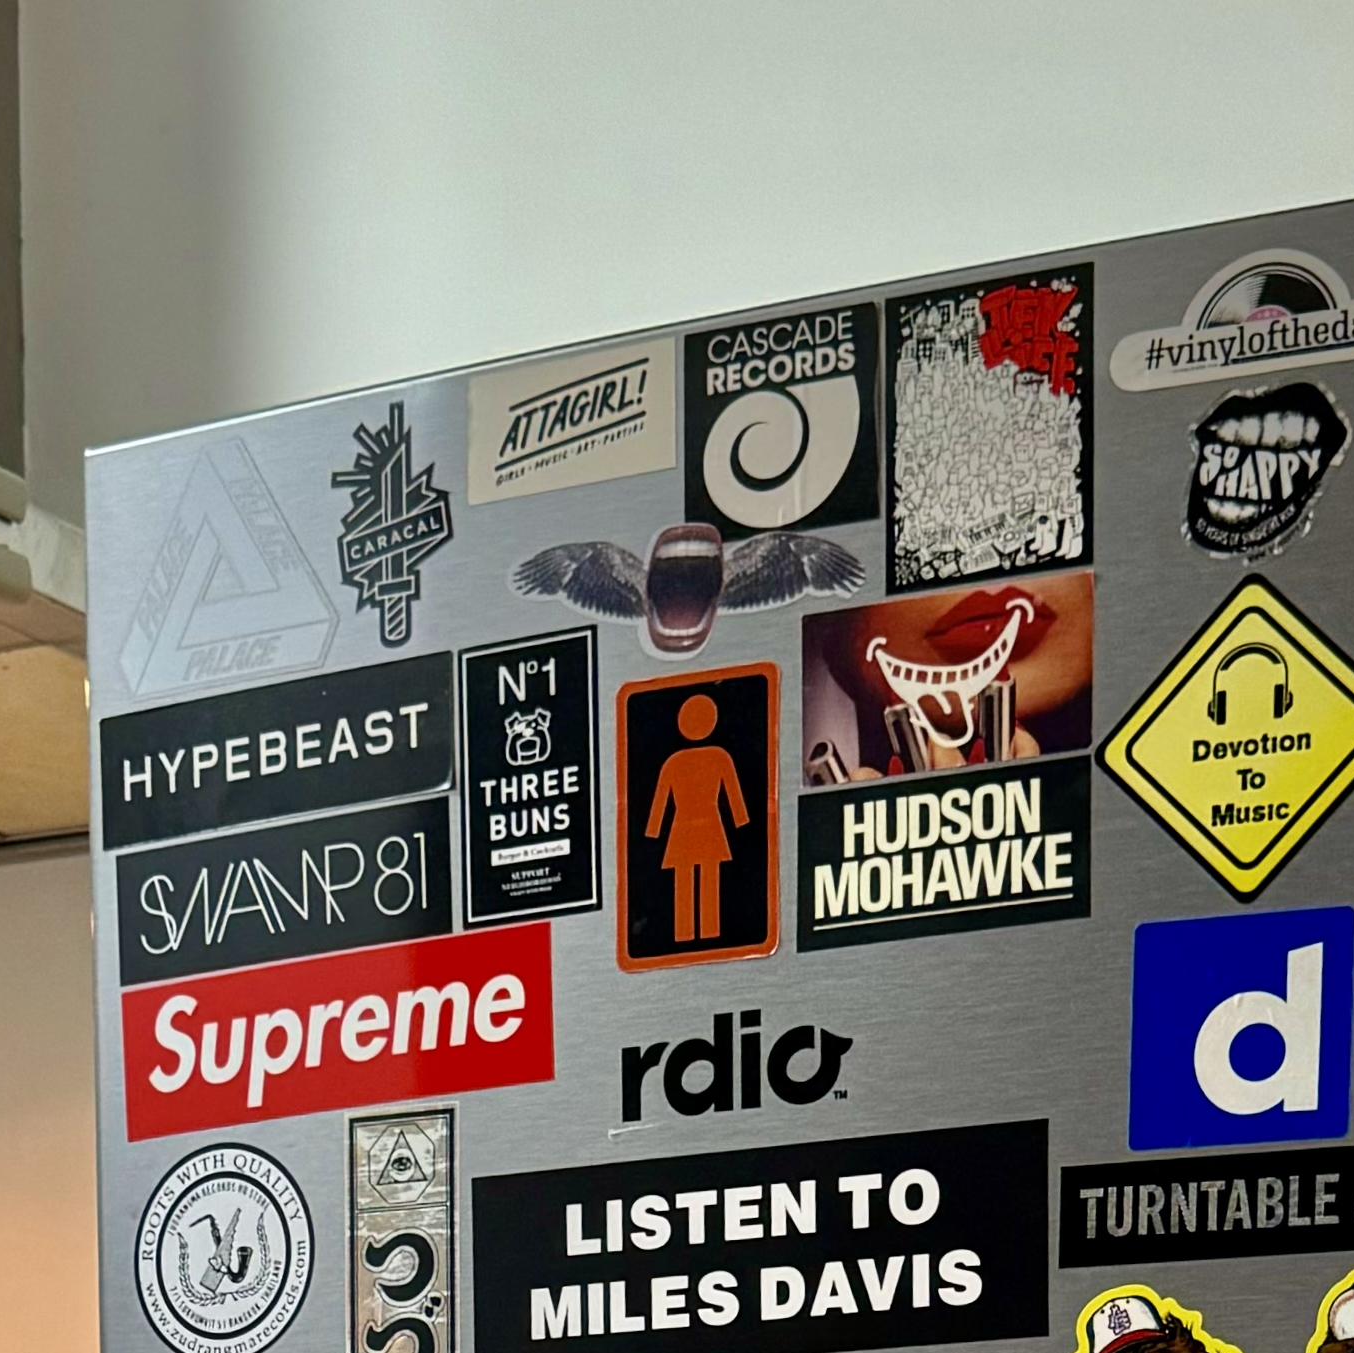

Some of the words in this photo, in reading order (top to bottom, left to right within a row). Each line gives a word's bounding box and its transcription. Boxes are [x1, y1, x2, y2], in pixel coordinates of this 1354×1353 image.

[707, 311, 853, 363] CASCADE
[706, 342, 856, 396] RECORDS
[499, 369, 647, 457] ATTAGIRL!
[535, 452, 568, 471] MUSIC
[576, 441, 595, 455] ART
[603, 422, 645, 446] PARTIES
[1200, 444, 1240, 486] SO
[1215, 449, 1321, 500] HAPPY
[350, 516, 441, 559] CARACAL
[182, 634, 281, 682] PALACE
[123, 702, 428, 801] HYPEBEAST
[1192, 732, 1311, 762] Devotion
[480, 766, 579, 806] THREE
[1236, 768, 1266, 791] To
[489, 804, 570, 841] BUNS
[843, 777, 1041, 858] HUDSON
[1211, 802, 1290, 827] Music
[140, 842, 365, 955] SWAMP
[374, 832, 427, 916] 81
[814, 832, 1073, 920] MOHAWKE
[148, 973, 526, 1107] Supreme
[1193, 941, 1324, 1115] d
[621, 1008, 853, 1123] rdio
[142, 1186, 175, 1261] ROOTS
[176, 1153, 225, 1185] WITH
[233, 1154, 303, 1221] QUALITY
[565, 1179, 816, 1257] LISTEN
[838, 1168, 940, 1229] TO
[1079, 1172, 1340, 1239] TURNTABLE
[530, 1270, 739, 1341] MILES
[760, 1249, 983, 1321] DAVIS
